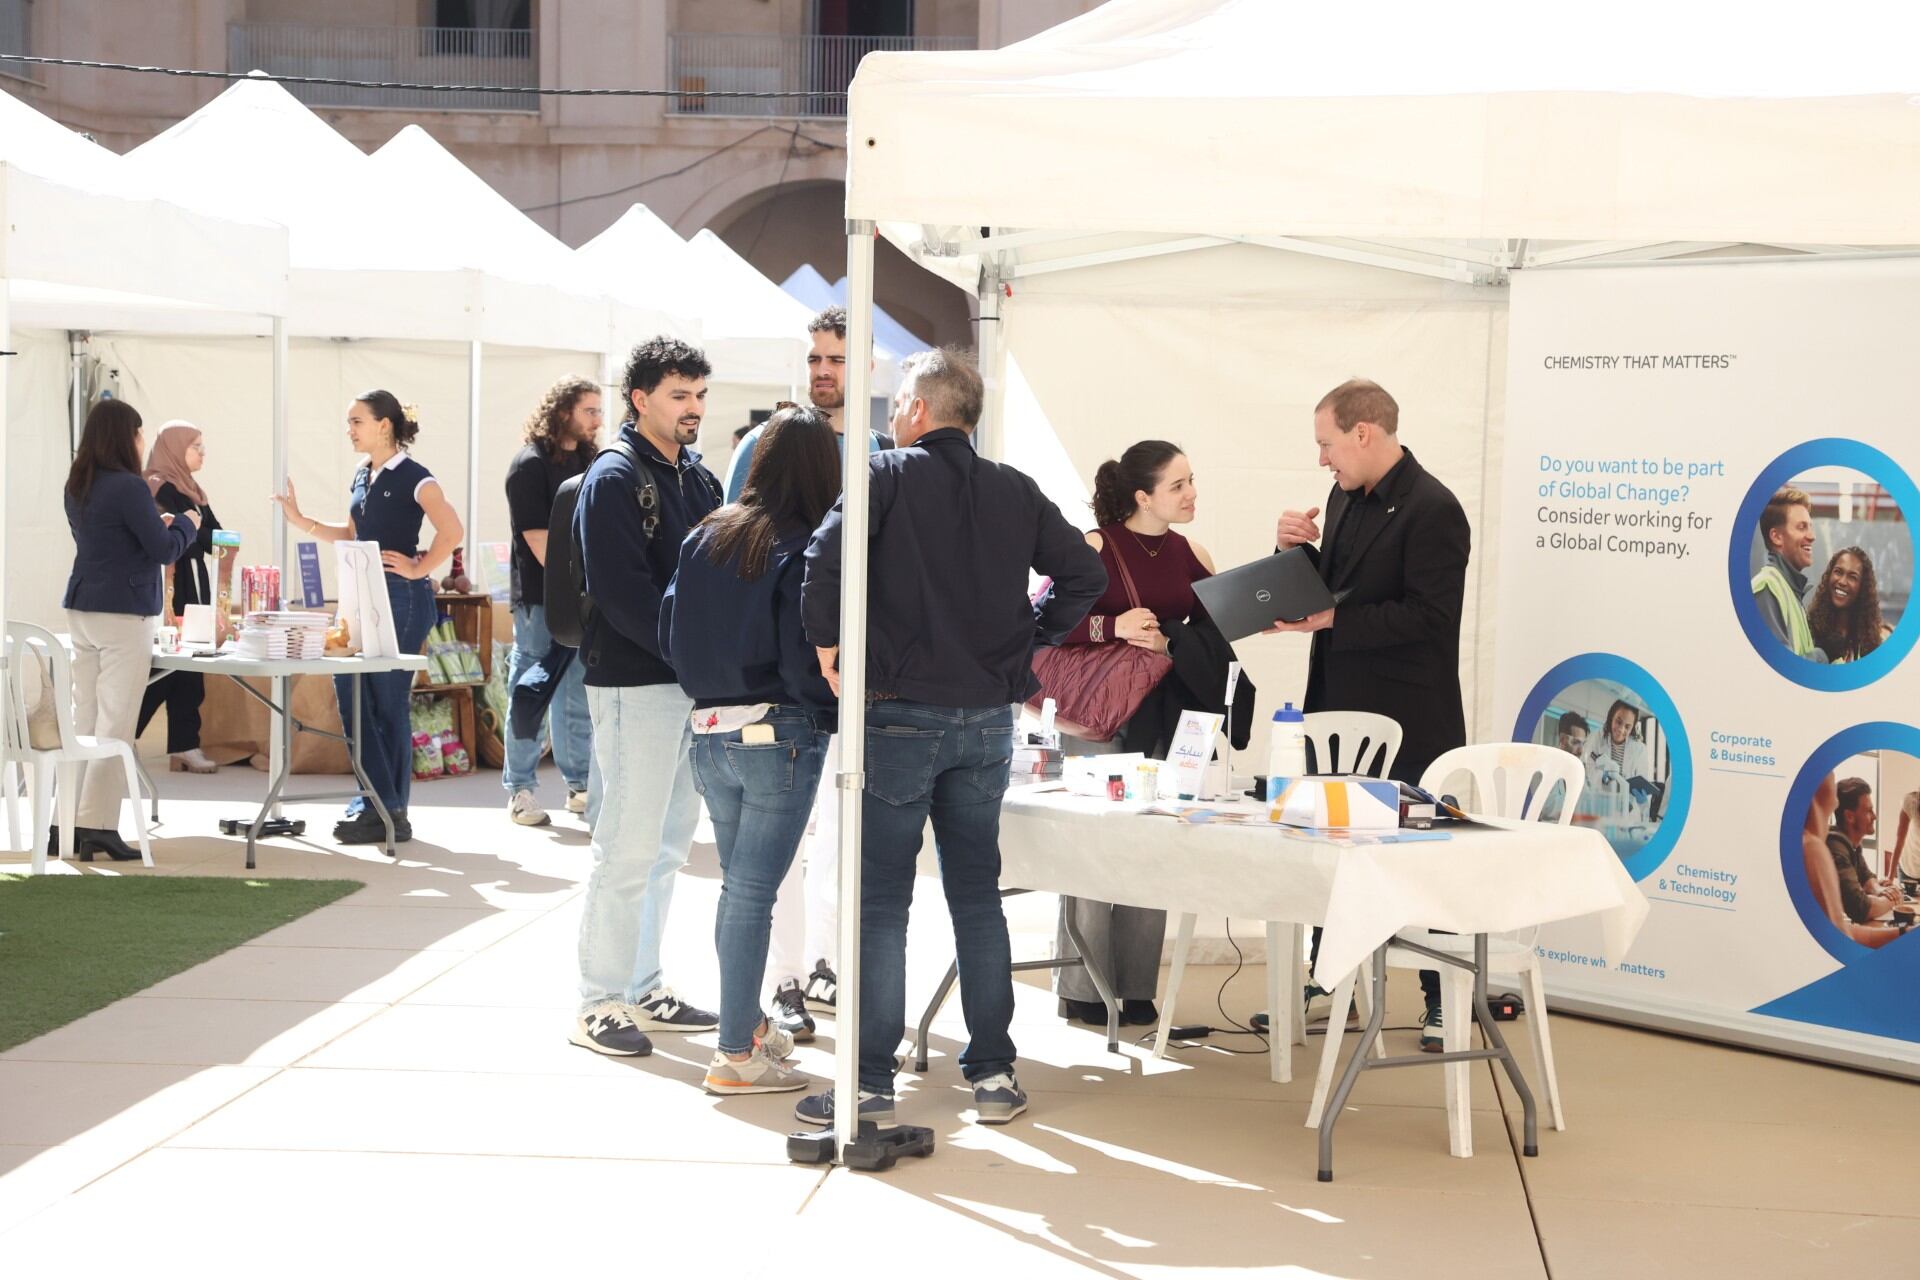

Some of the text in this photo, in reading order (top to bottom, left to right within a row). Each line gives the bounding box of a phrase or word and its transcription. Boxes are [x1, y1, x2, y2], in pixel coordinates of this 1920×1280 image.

[1544, 355, 1619, 369] CHEMISTRY
[1622, 355, 1659, 368] THAT
[1540, 455, 1724, 479] Do you want to be part
[1538, 480, 1689, 506] of Global Change?
[1537, 506, 1712, 532] Consider working for
[1535, 532, 1689, 559] a Global Company.
[1710, 731, 1773, 747] Corporate
[1710, 748, 1775, 765] & Business
[1676, 864, 1738, 884] Chemistry
[1658, 878, 1737, 902] & Technology
[1548, 949, 1589, 966] explore
[1620, 962, 1666, 979] matters
